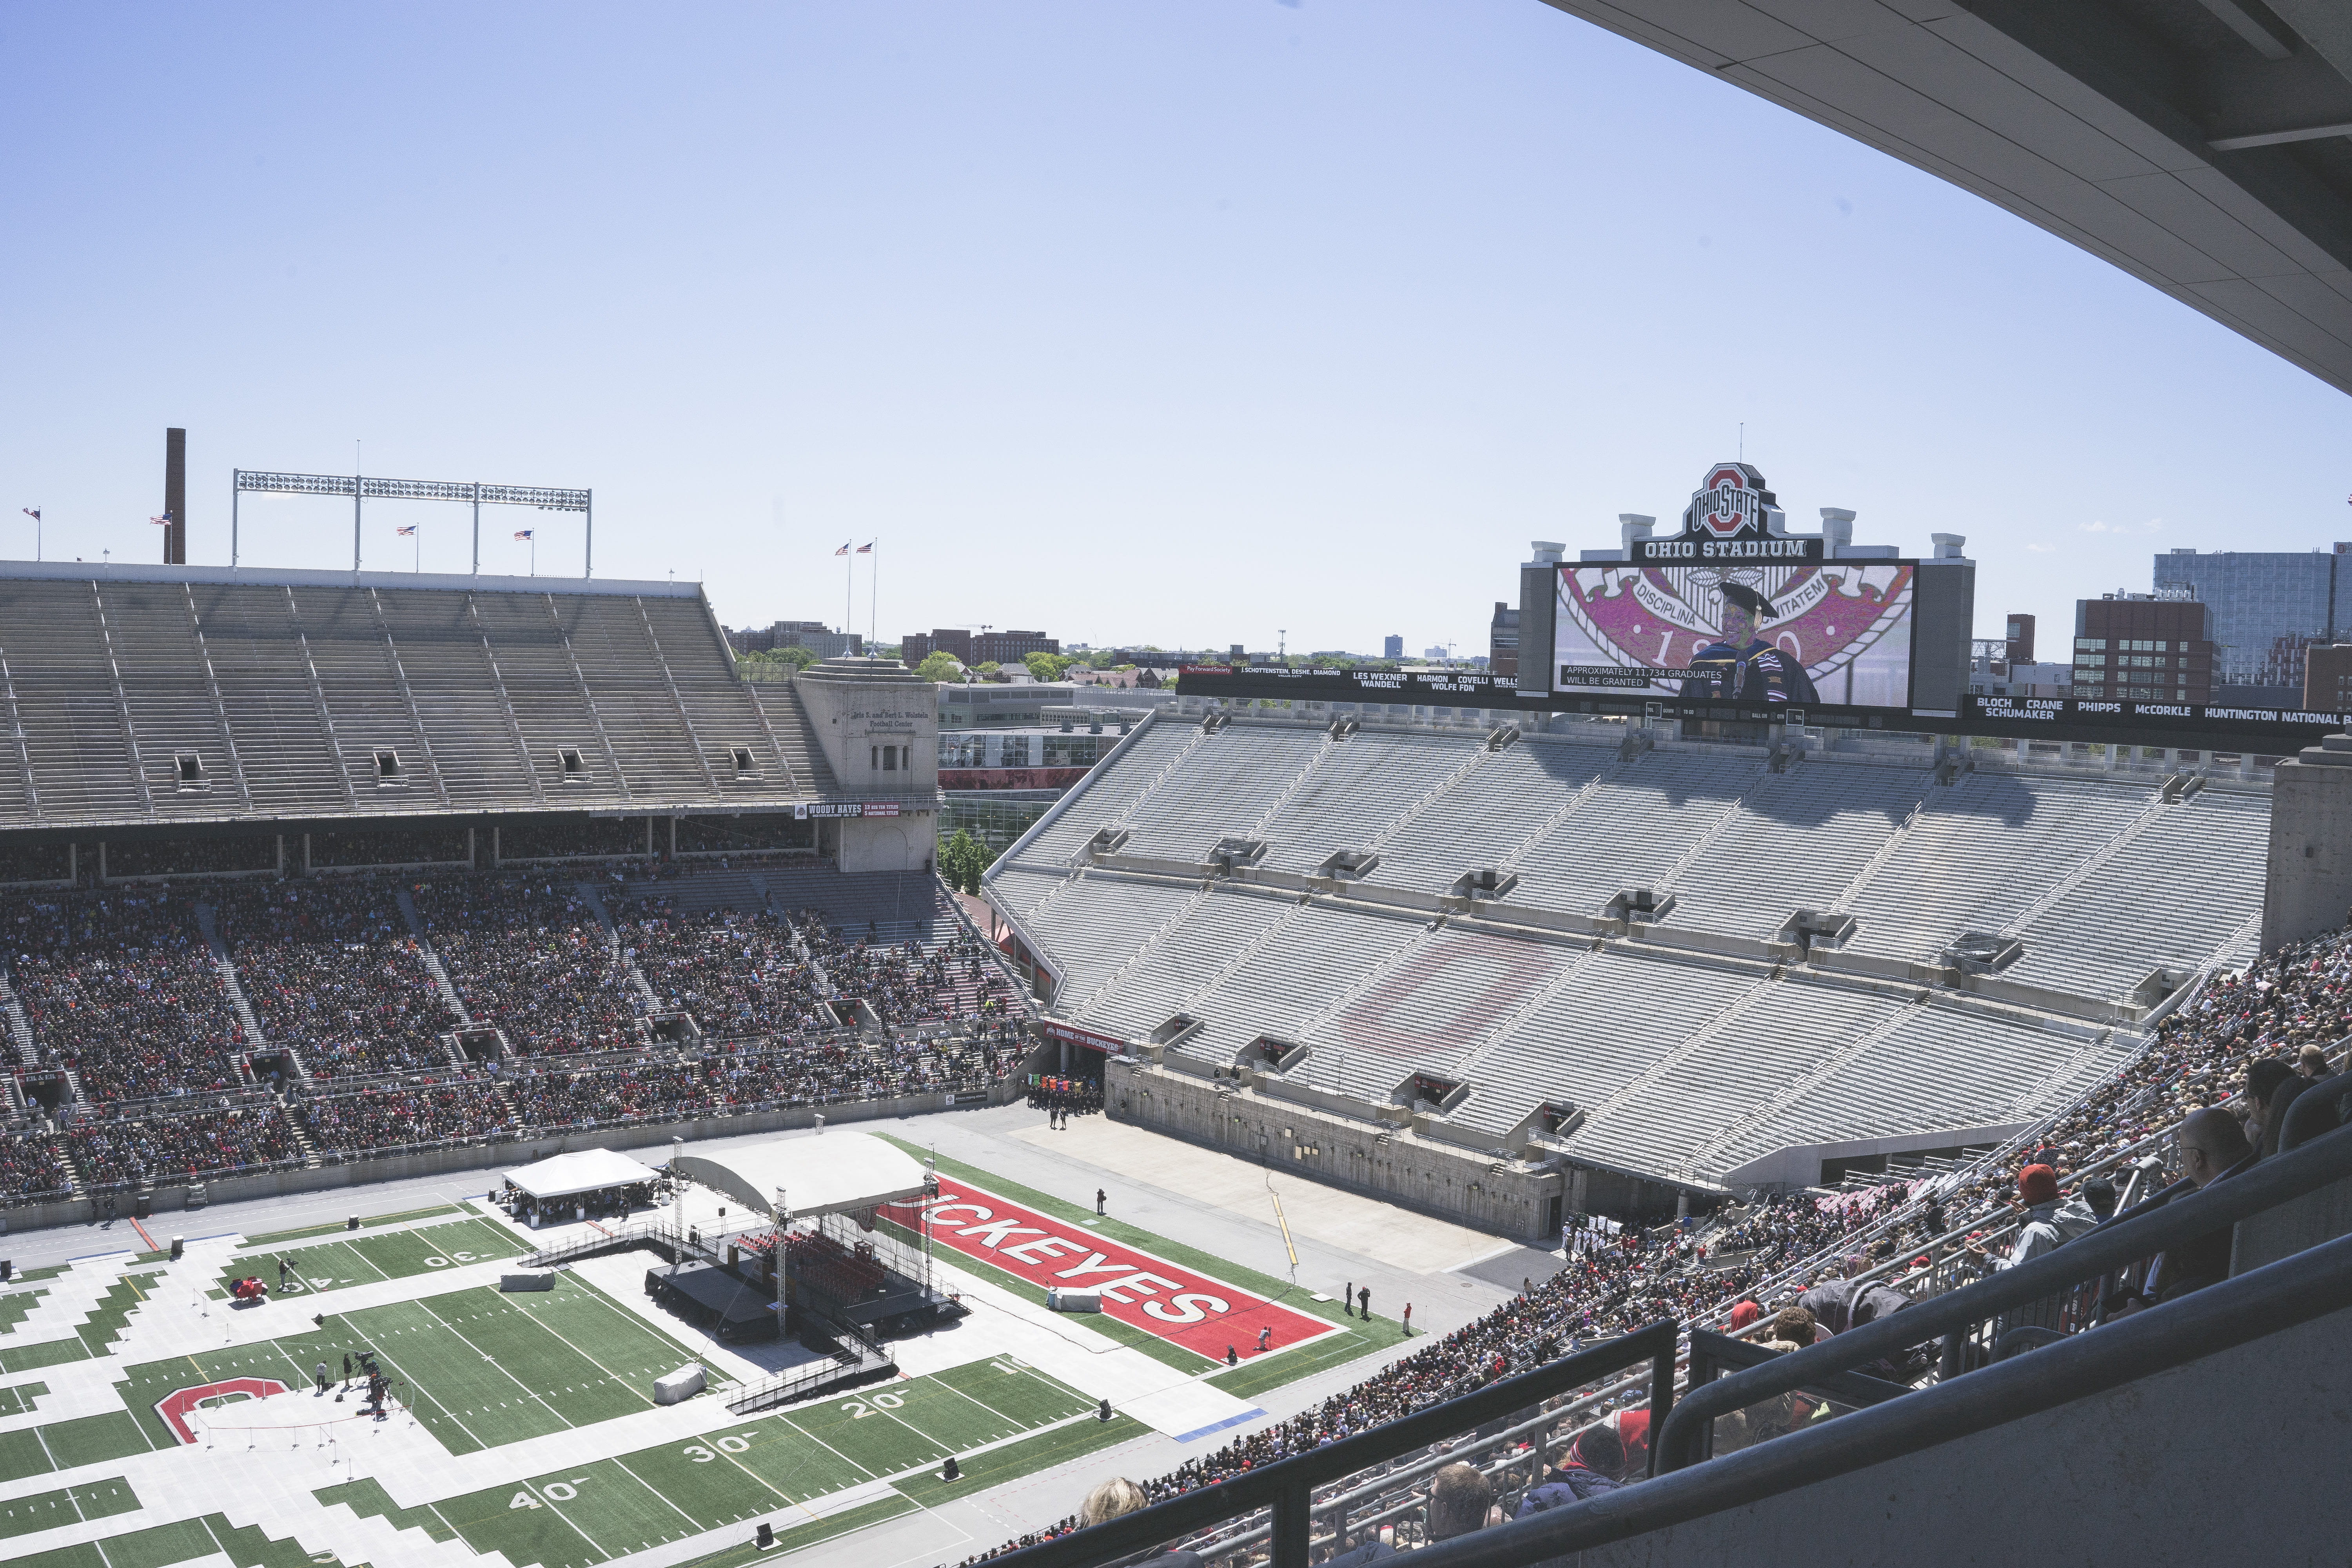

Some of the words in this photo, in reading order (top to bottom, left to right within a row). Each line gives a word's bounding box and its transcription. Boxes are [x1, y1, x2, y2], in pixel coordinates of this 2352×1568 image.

[1694, 490, 1720, 529] OHIO
[1721, 485, 1757, 529] STATE
[1645, 542, 1697, 558] OHIO
[1703, 540, 1807, 557] STADIUM
[1636, 583, 1696, 627] DISCIPLINA
[1370, 673, 1407, 681] WEXNER
[1567, 666, 1632, 676] APPROXIMATELY
[1636, 668, 1665, 677] 11,734
[1668, 670, 1722, 679] GRADUATES
[1361, 680, 1401, 688] WANDELL
[1417, 675, 1448, 683] HARMON
[1458, 676, 1488, 684] COVELLI
[1603, 678, 1643, 686] GRANTED
[1432, 682, 1457, 691] WOLFE
[1459, 684, 1474, 692] FDN
[1977, 698, 2012, 708] BLOCH
[2027, 700, 2063, 710] CRANE
[2078, 702, 2121, 713] PHIPPS
[1985, 708, 2054, 720] SCHUMAKER
[2135, 704, 2191, 716] McCORKLE
[2205, 708, 2277, 721] HUNTINGTON
[2282, 712, 2340, 724] NATIONAL
[809, 805, 836, 814] WOODY
[837, 804, 862, 813] HAYES
[1056, 1028, 1074, 1040] HOME
[1086, 1036, 1119, 1052] BUCKEYES
[841, 1392, 905, 1419] 20
[683, 1435, 752, 1463] 30
[508, 1482, 578, 1510] 40
